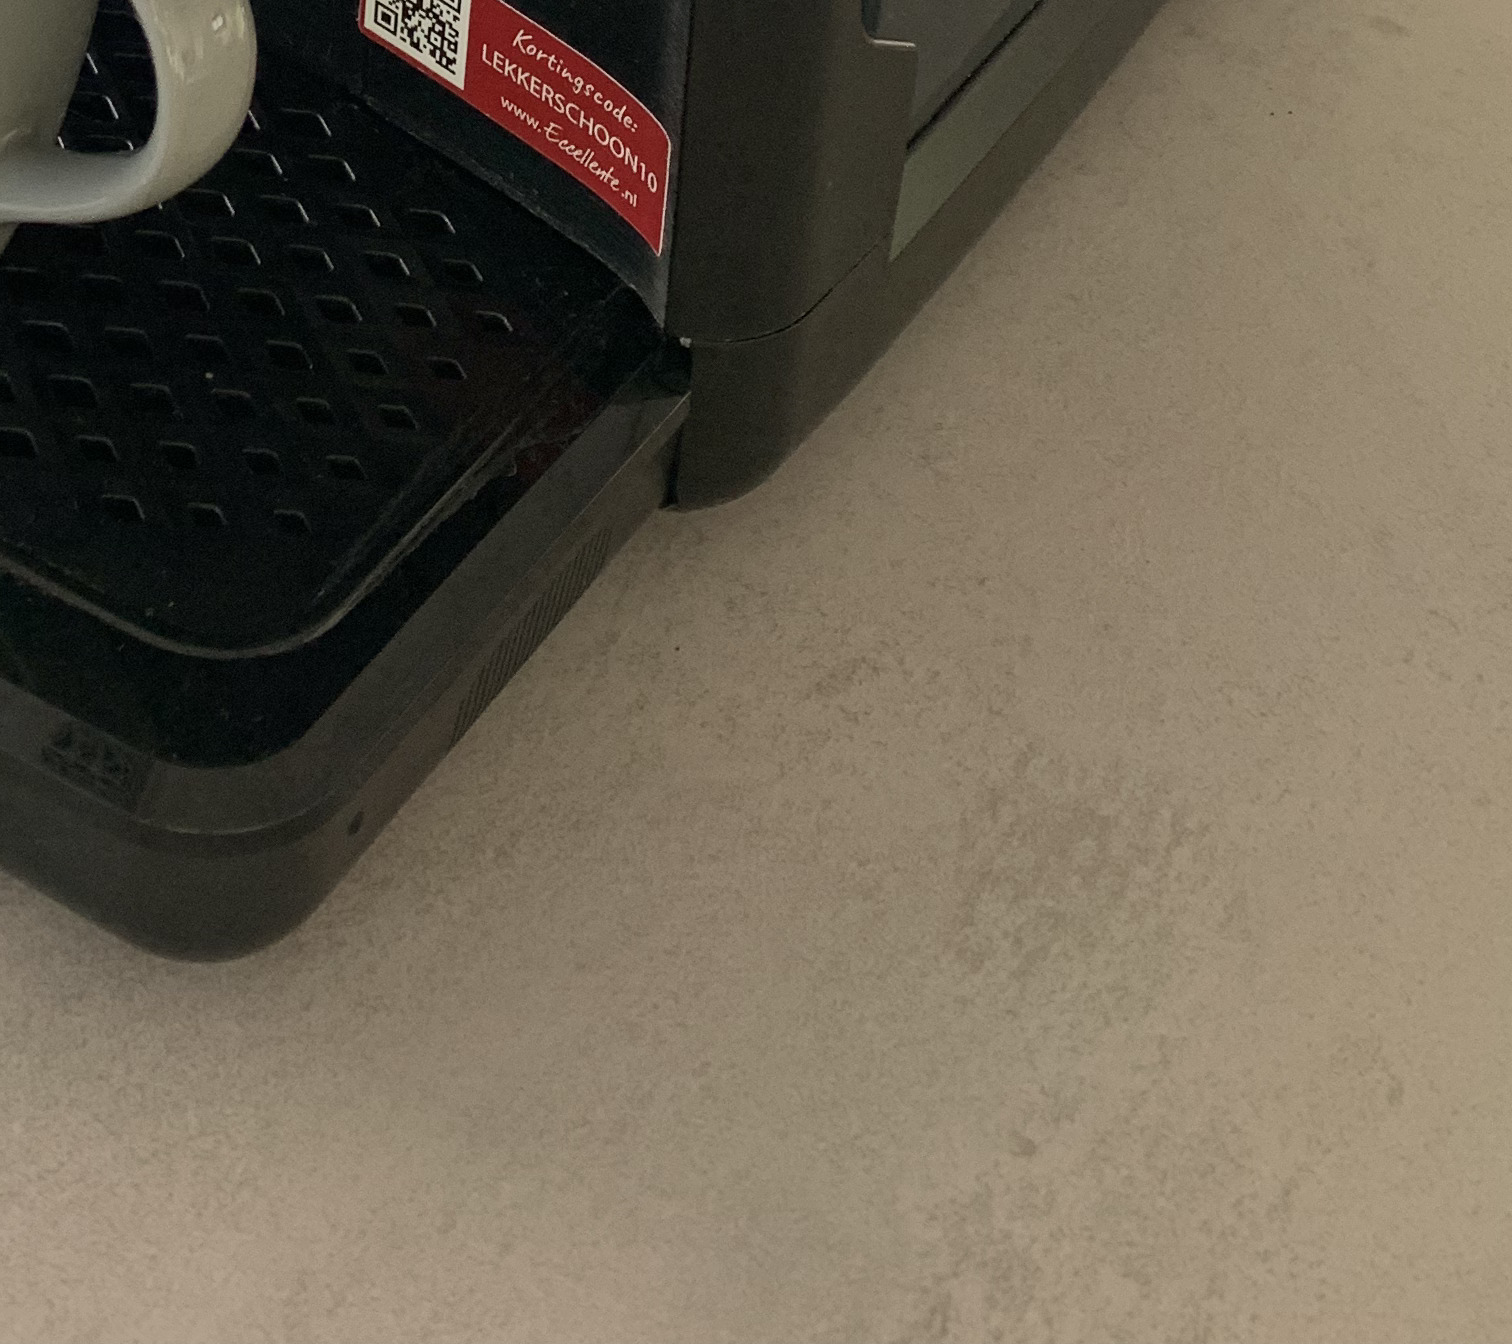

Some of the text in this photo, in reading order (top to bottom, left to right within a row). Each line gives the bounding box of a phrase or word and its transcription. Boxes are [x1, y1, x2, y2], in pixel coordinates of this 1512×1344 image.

[481, 44, 658, 193] LEKKERSCHOON10
[513, 29, 638, 133] Kortingscode:
[500, 97, 637, 207] www.Eccellente.nl
